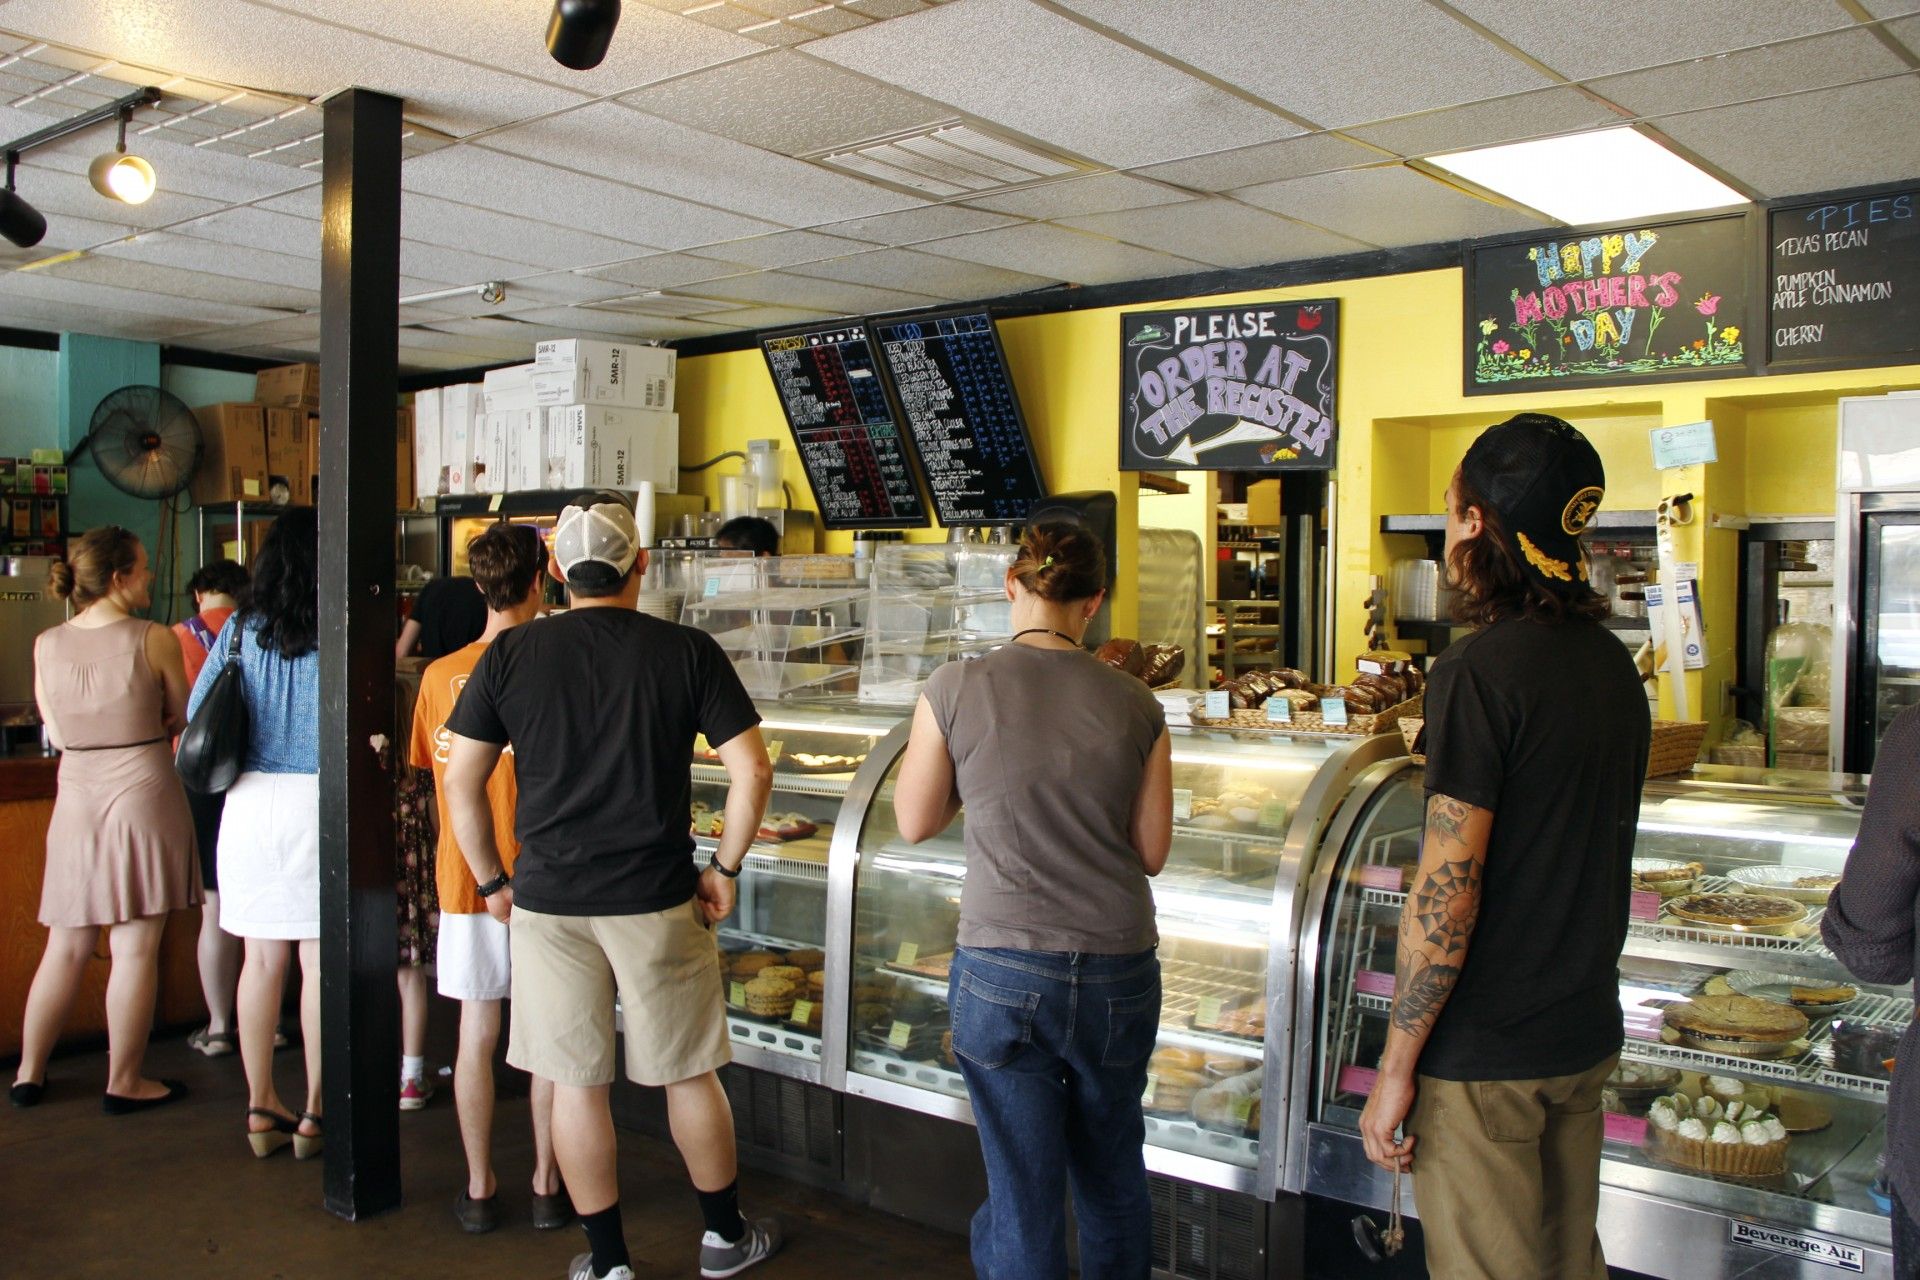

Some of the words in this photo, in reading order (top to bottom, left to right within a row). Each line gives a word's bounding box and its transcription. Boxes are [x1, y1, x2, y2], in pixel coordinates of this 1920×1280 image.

[1807, 196, 1912, 230] PIES
[1776, 234, 1820, 256] TEXAS
[1825, 229, 1868, 251] PECAN
[1773, 288, 1807, 310] APPLE
[1813, 281, 1892, 305] CINNAMON
[1777, 269, 1835, 291] PUMPKIN
[1514, 272, 1681, 326] MOTHER'S
[1571, 308, 1636, 351] DAY
[1775, 324, 1823, 346] CHERRY
[611, 348, 620, 385] SMR-12
[1140, 341, 1248, 408] ORDER
[1254, 344, 1311, 394] AT
[1140, 388, 1205, 445] THE
[1206, 377, 1331, 457] REGISTER
[617, 449, 625, 486] SMR-12
